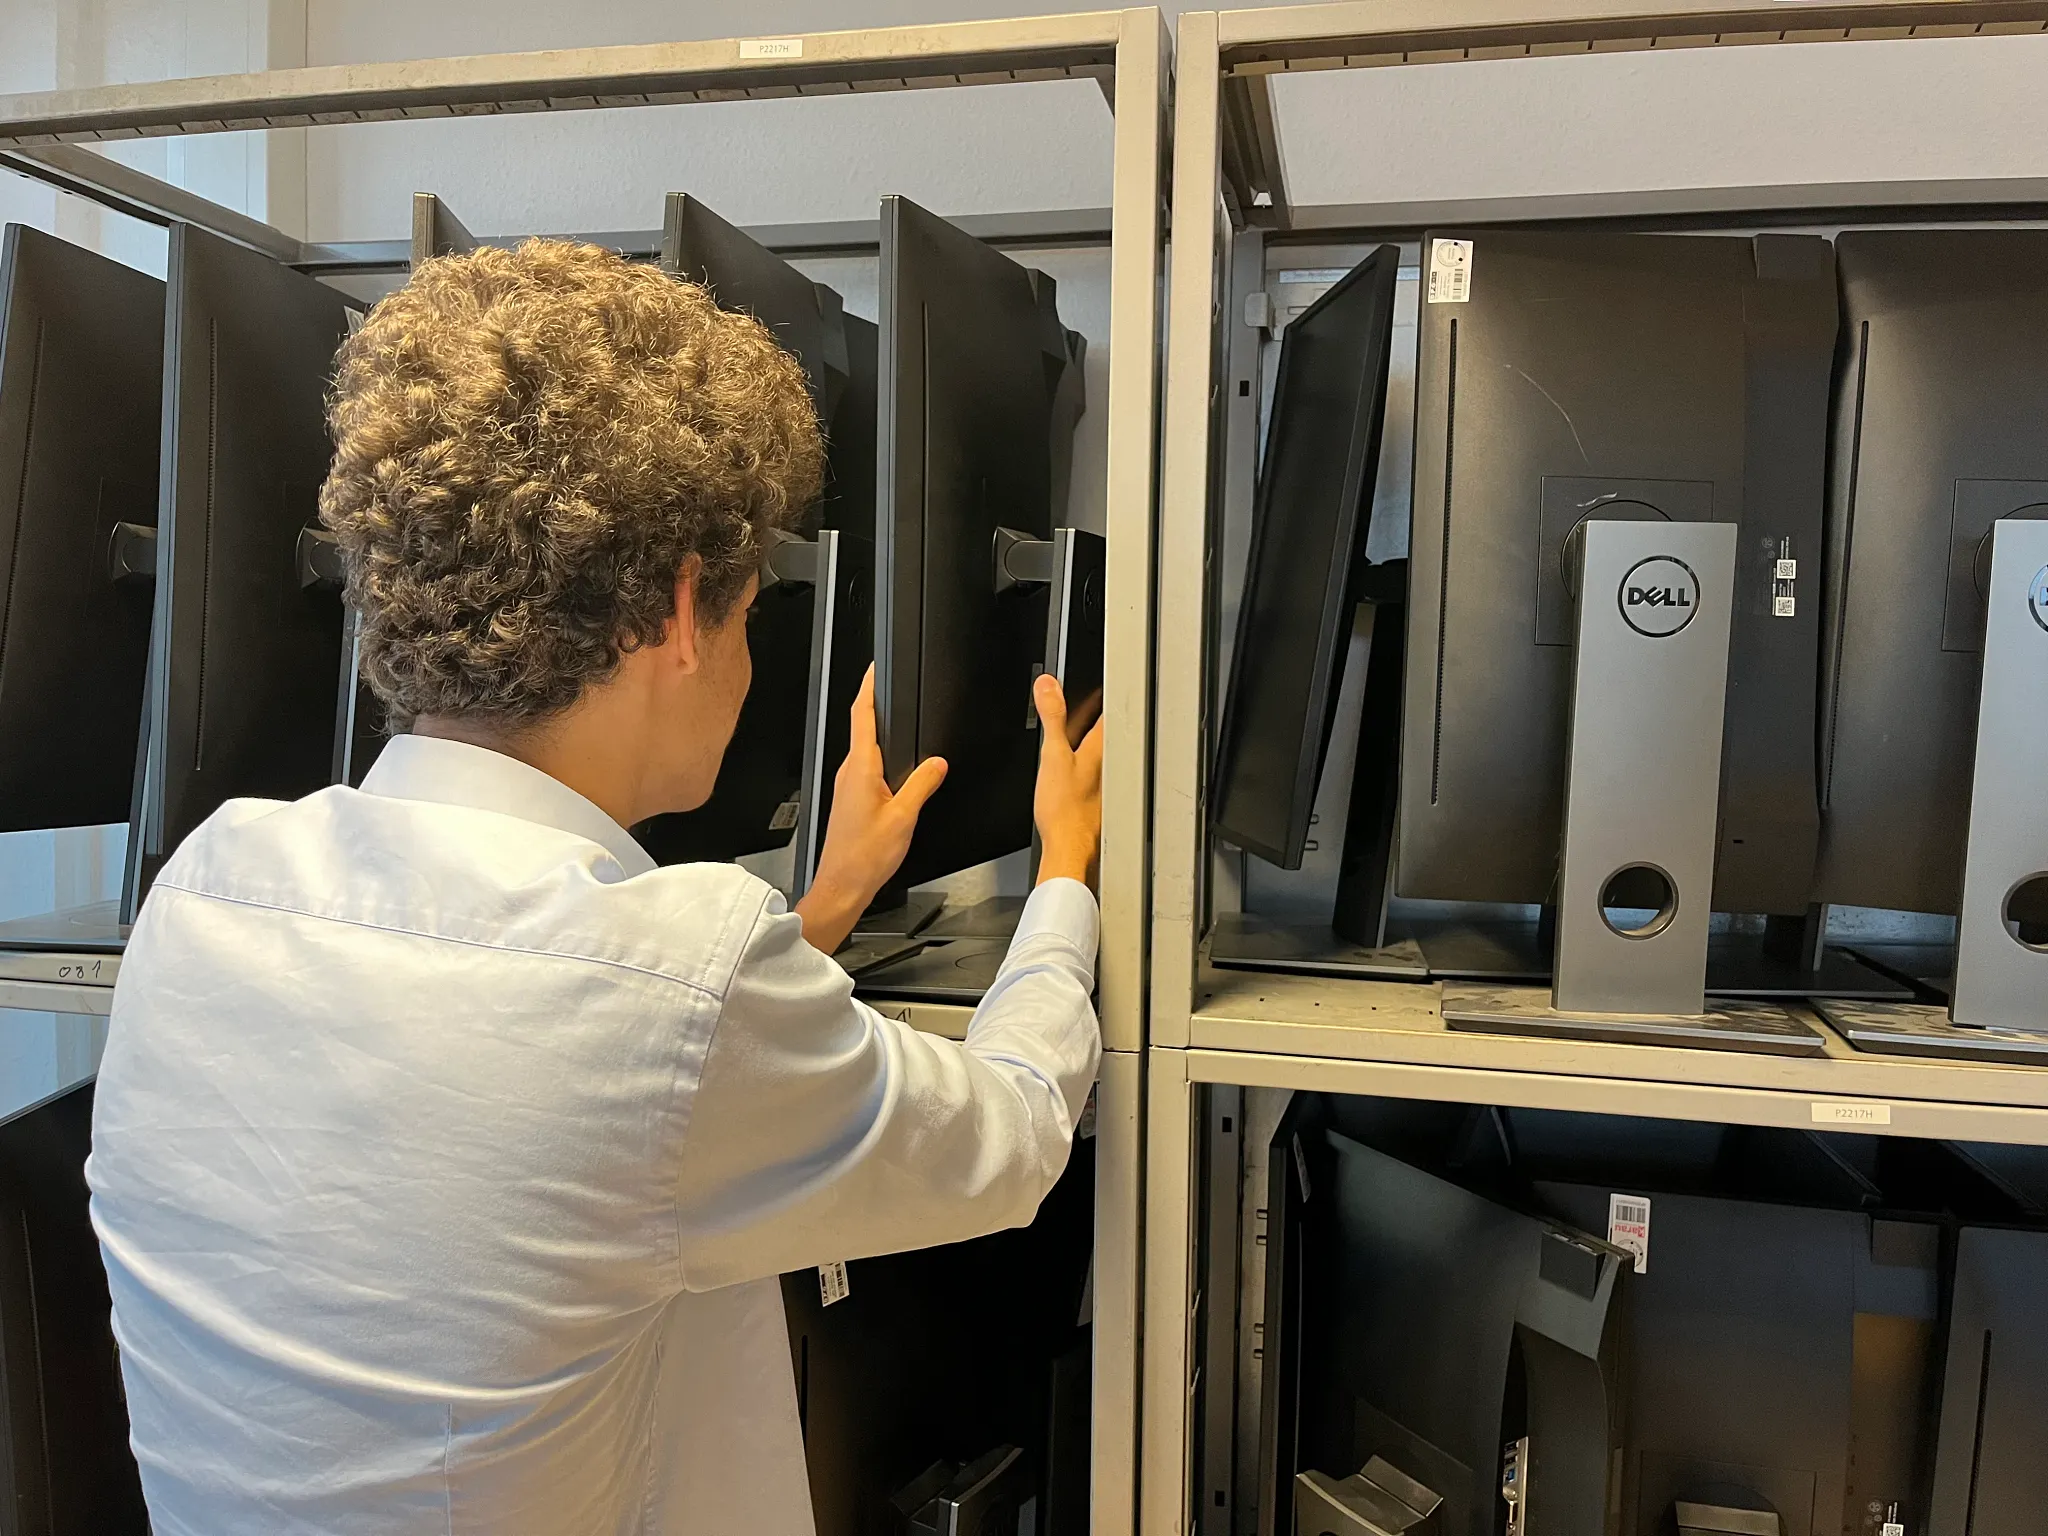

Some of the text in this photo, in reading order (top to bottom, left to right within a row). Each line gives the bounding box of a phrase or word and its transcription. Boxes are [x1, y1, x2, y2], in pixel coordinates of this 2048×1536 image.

[759, 44, 789, 53] P2217H
[1627, 586, 1690, 607] DELL
[1835, 1109, 1873, 1119] P2217H
